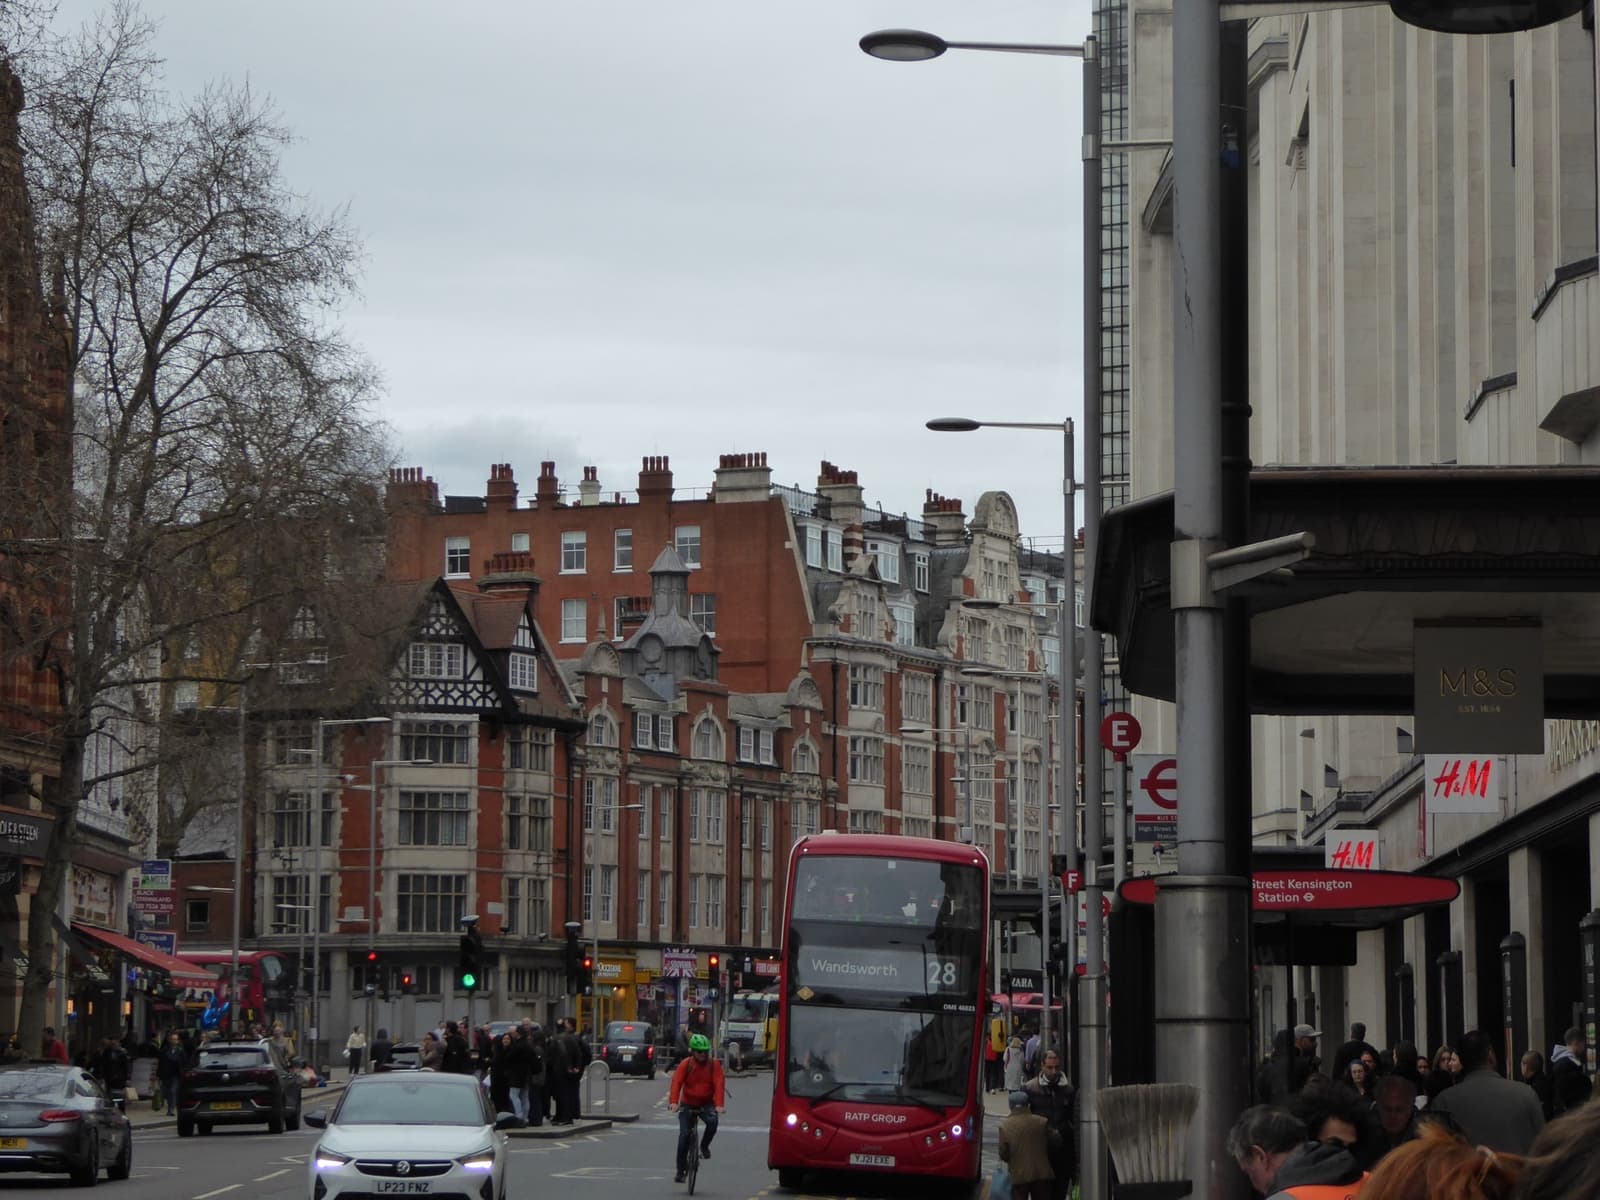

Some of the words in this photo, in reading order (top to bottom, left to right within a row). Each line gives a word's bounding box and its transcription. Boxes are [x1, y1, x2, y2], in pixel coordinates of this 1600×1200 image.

[1440, 667, 1517, 697] M&S
[1112, 720, 1129, 747] E
[1433, 759, 1493, 799] H&M
[1331, 840, 1375, 870] H&M
[1067, 873, 1078, 889] F
[1288, 879, 1352, 891] Kensington
[1258, 892, 1300, 903] Station
[812, 958, 898, 977] Wandsworth
[928, 961, 956, 985] 28
[1011, 977, 1033, 988] ZARA
[844, 1111, 870, 1121] RATP
[871, 1113, 907, 1124] GROUP
[377, 1182, 405, 1193] LP23
[408, 1182, 429, 1193] FNZ
